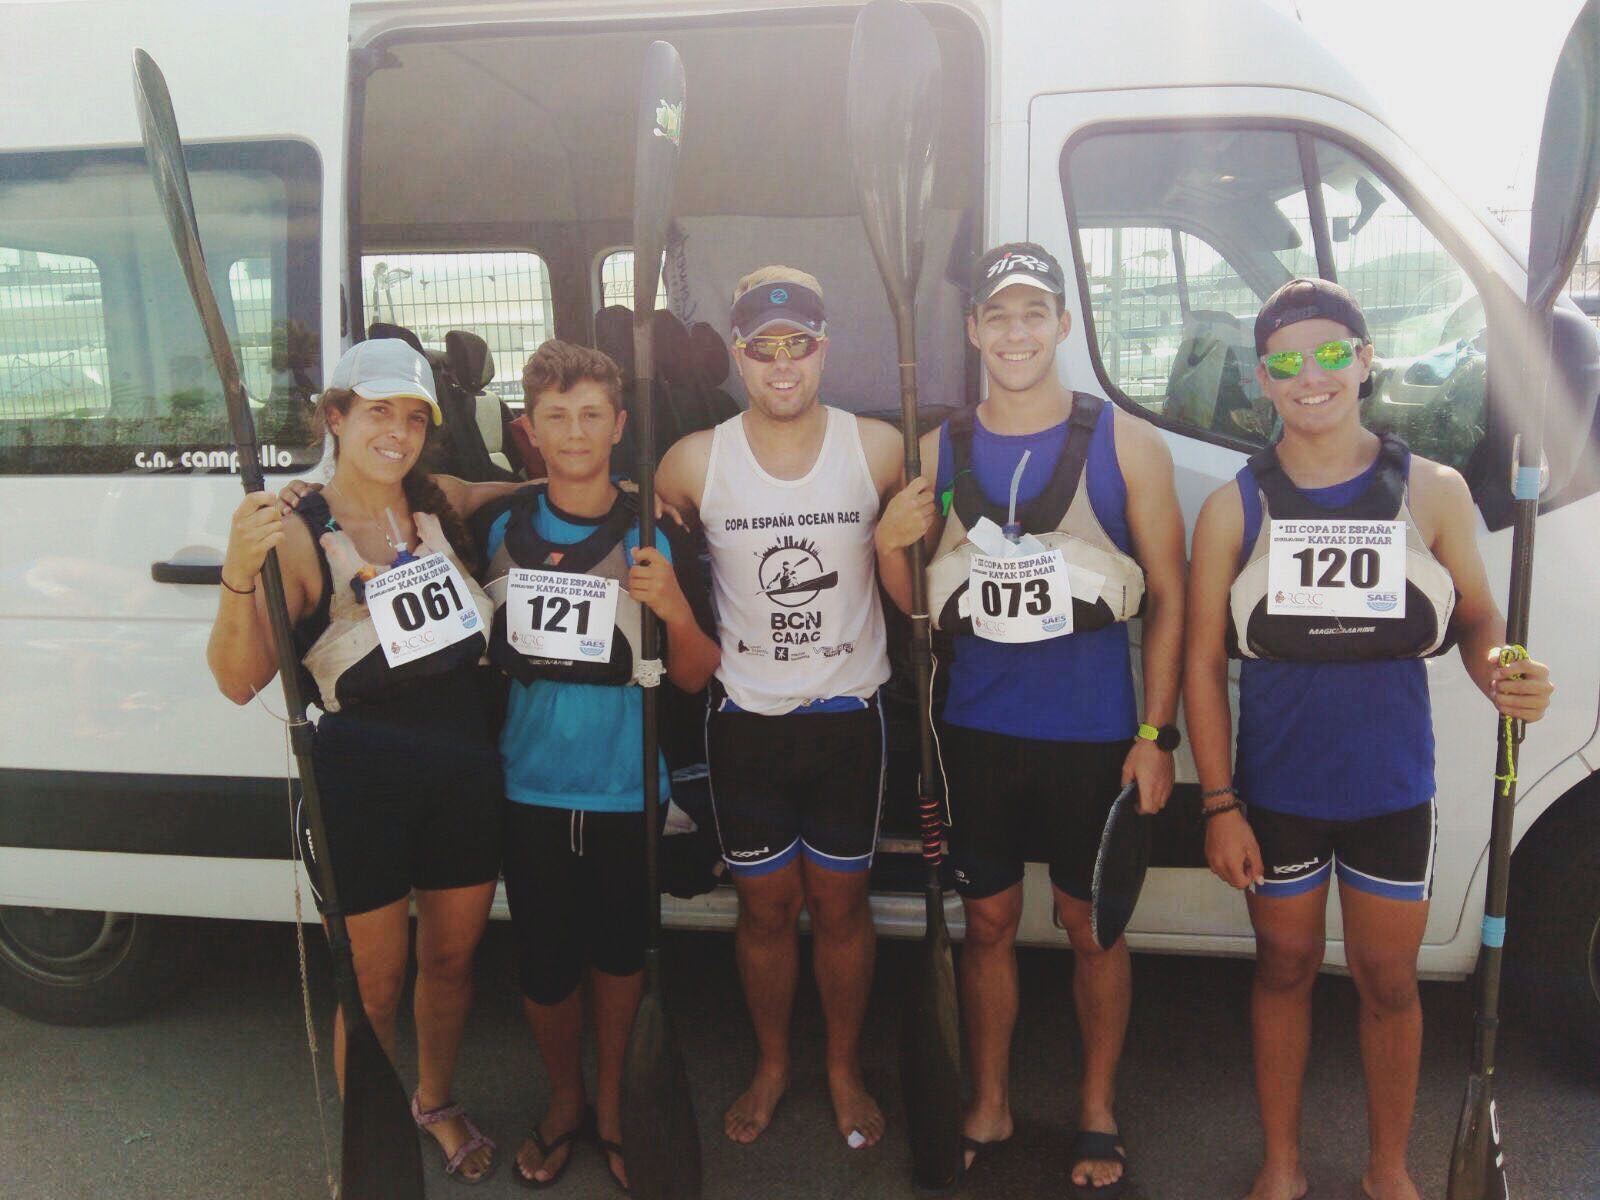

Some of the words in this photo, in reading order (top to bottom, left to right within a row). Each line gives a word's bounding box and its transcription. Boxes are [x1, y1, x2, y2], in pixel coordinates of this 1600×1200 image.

[134, 451, 173, 467] c.n.
[181, 445, 292, 474] campllo
[725, 518, 749, 531] COPA
[752, 512, 795, 529] ESPAÑA
[798, 512, 835, 526] OCEAN
[838, 511, 860, 524] RACE
[1285, 525, 1297, 534] III
[1298, 525, 1330, 534] COPA
[1331, 525, 1347, 534] DE
[1348, 523, 1392, 534] ESPAÑA
[1308, 536, 1346, 545] KAYAK
[1348, 536, 1363, 545] DE
[1365, 536, 1392, 545] MAR
[984, 560, 1002, 570] COPA
[1003, 562, 1017, 570] DE
[1018, 554, 1054, 569] ESPAÑA
[1293, 547, 1380, 589] 120
[376, 576, 386, 589] III
[387, 568, 415, 584] COPA
[415, 563, 428, 573] DE
[398, 572, 431, 590] KAYAK
[519, 573, 529, 582] III
[529, 574, 555, 584] COPA
[556, 576, 569, 585] DE
[569, 578, 607, 590] ESPAÑA
[988, 570, 1018, 580] KAYAK
[1019, 570, 1032, 579] DE
[1033, 565, 1056, 577] MAR
[536, 584, 568, 595] KAYAK
[569, 587, 581, 596] DE
[583, 588, 606, 599] MAR
[981, 578, 1052, 618] 073
[392, 575, 463, 631] 061
[527, 595, 591, 635] 121
[770, 611, 822, 630] BCN
[580, 640, 605, 648] SAES
[772, 631, 821, 646] CAIAC
